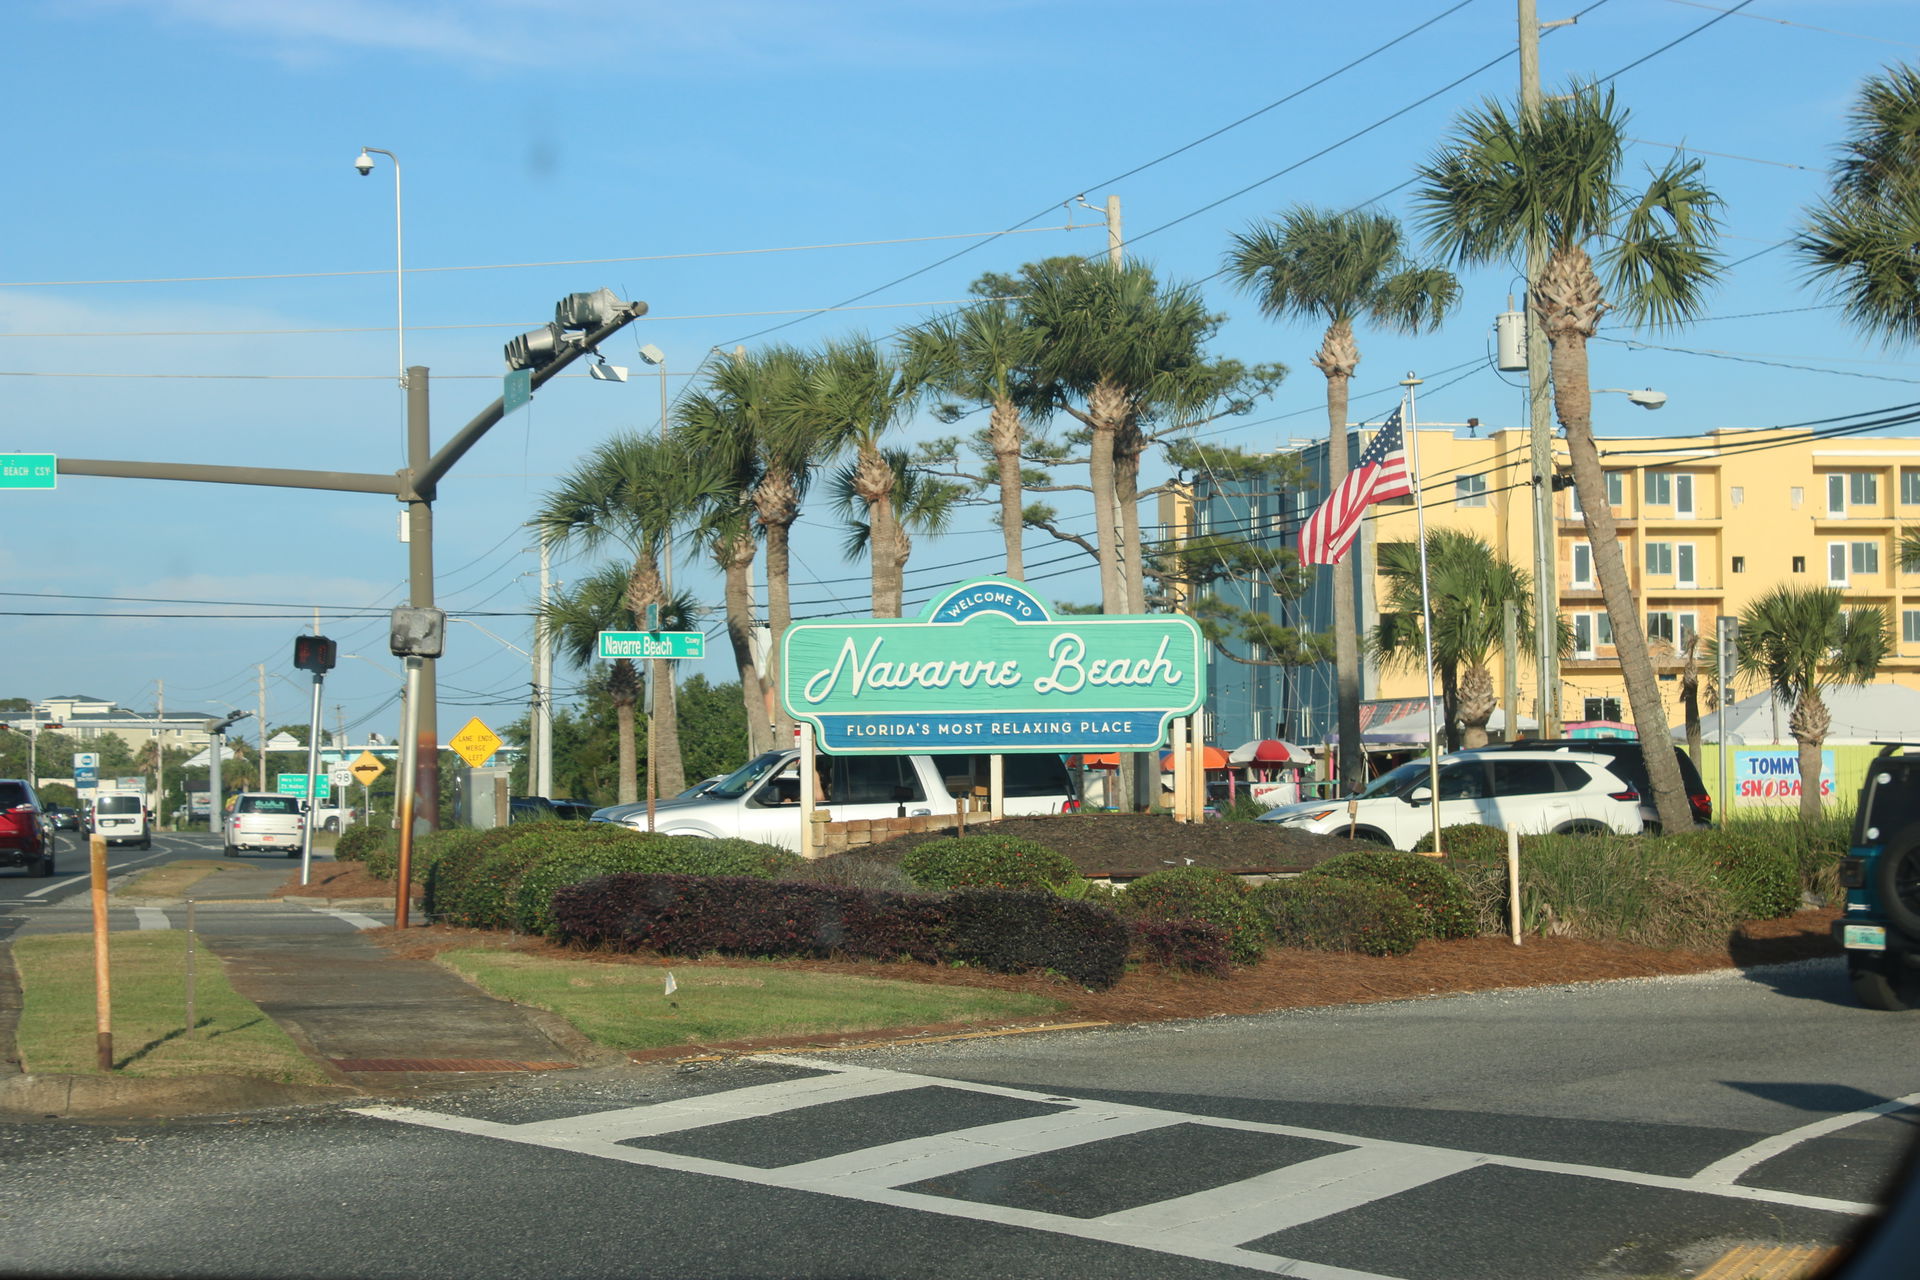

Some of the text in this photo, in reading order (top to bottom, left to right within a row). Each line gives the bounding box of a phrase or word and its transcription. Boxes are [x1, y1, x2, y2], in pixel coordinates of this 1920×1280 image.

[4, 466, 29, 476] BEACH
[947, 592, 1032, 617] WELCOME TO
[605, 635, 641, 655] Navarre
[643, 635, 673, 656] Beach
[803, 632, 1183, 704] Navarre Beach
[847, 721, 1132, 736] FLORIDA'S MOST RELAXING PLACE
[336, 773, 350, 782] 98
[1741, 779, 1830, 797] SNOBAS
